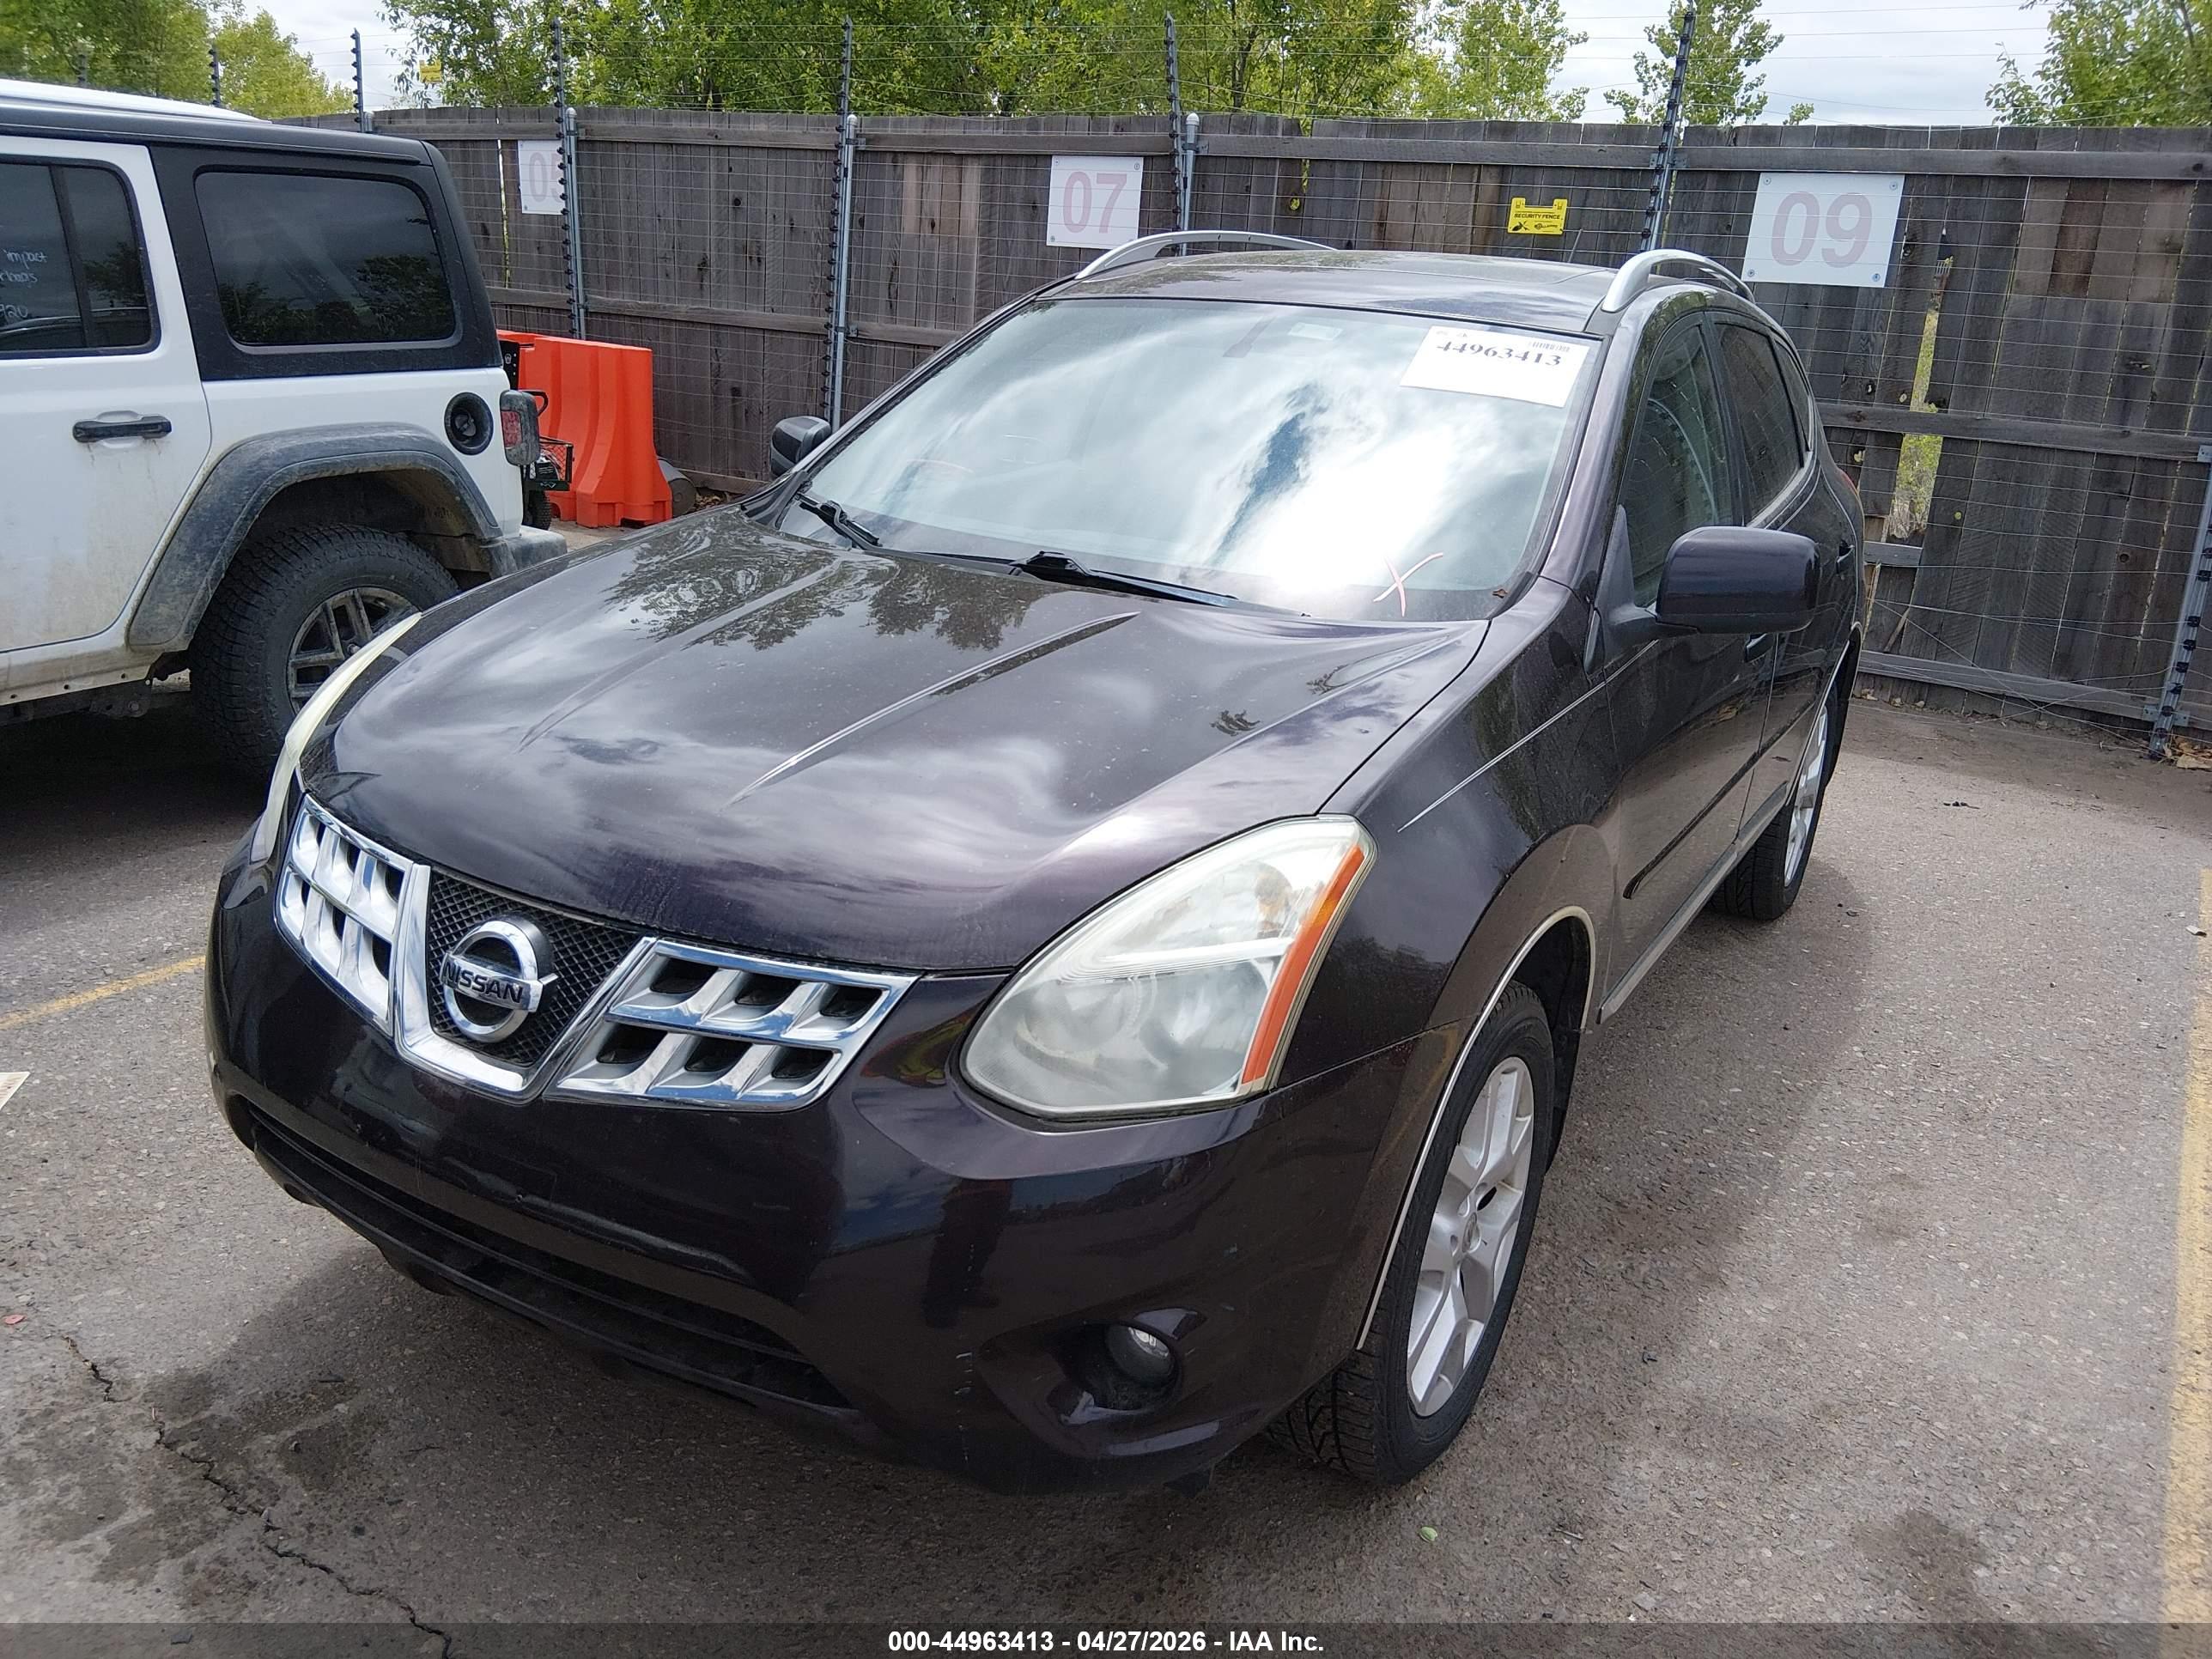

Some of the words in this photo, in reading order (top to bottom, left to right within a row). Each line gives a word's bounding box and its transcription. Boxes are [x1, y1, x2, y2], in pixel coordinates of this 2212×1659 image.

[1063, 171, 1127, 234] 07
[1771, 191, 1872, 268] 09
[1437, 341, 1561, 366] 44963413
[443, 961, 524, 1004] NISSAN
